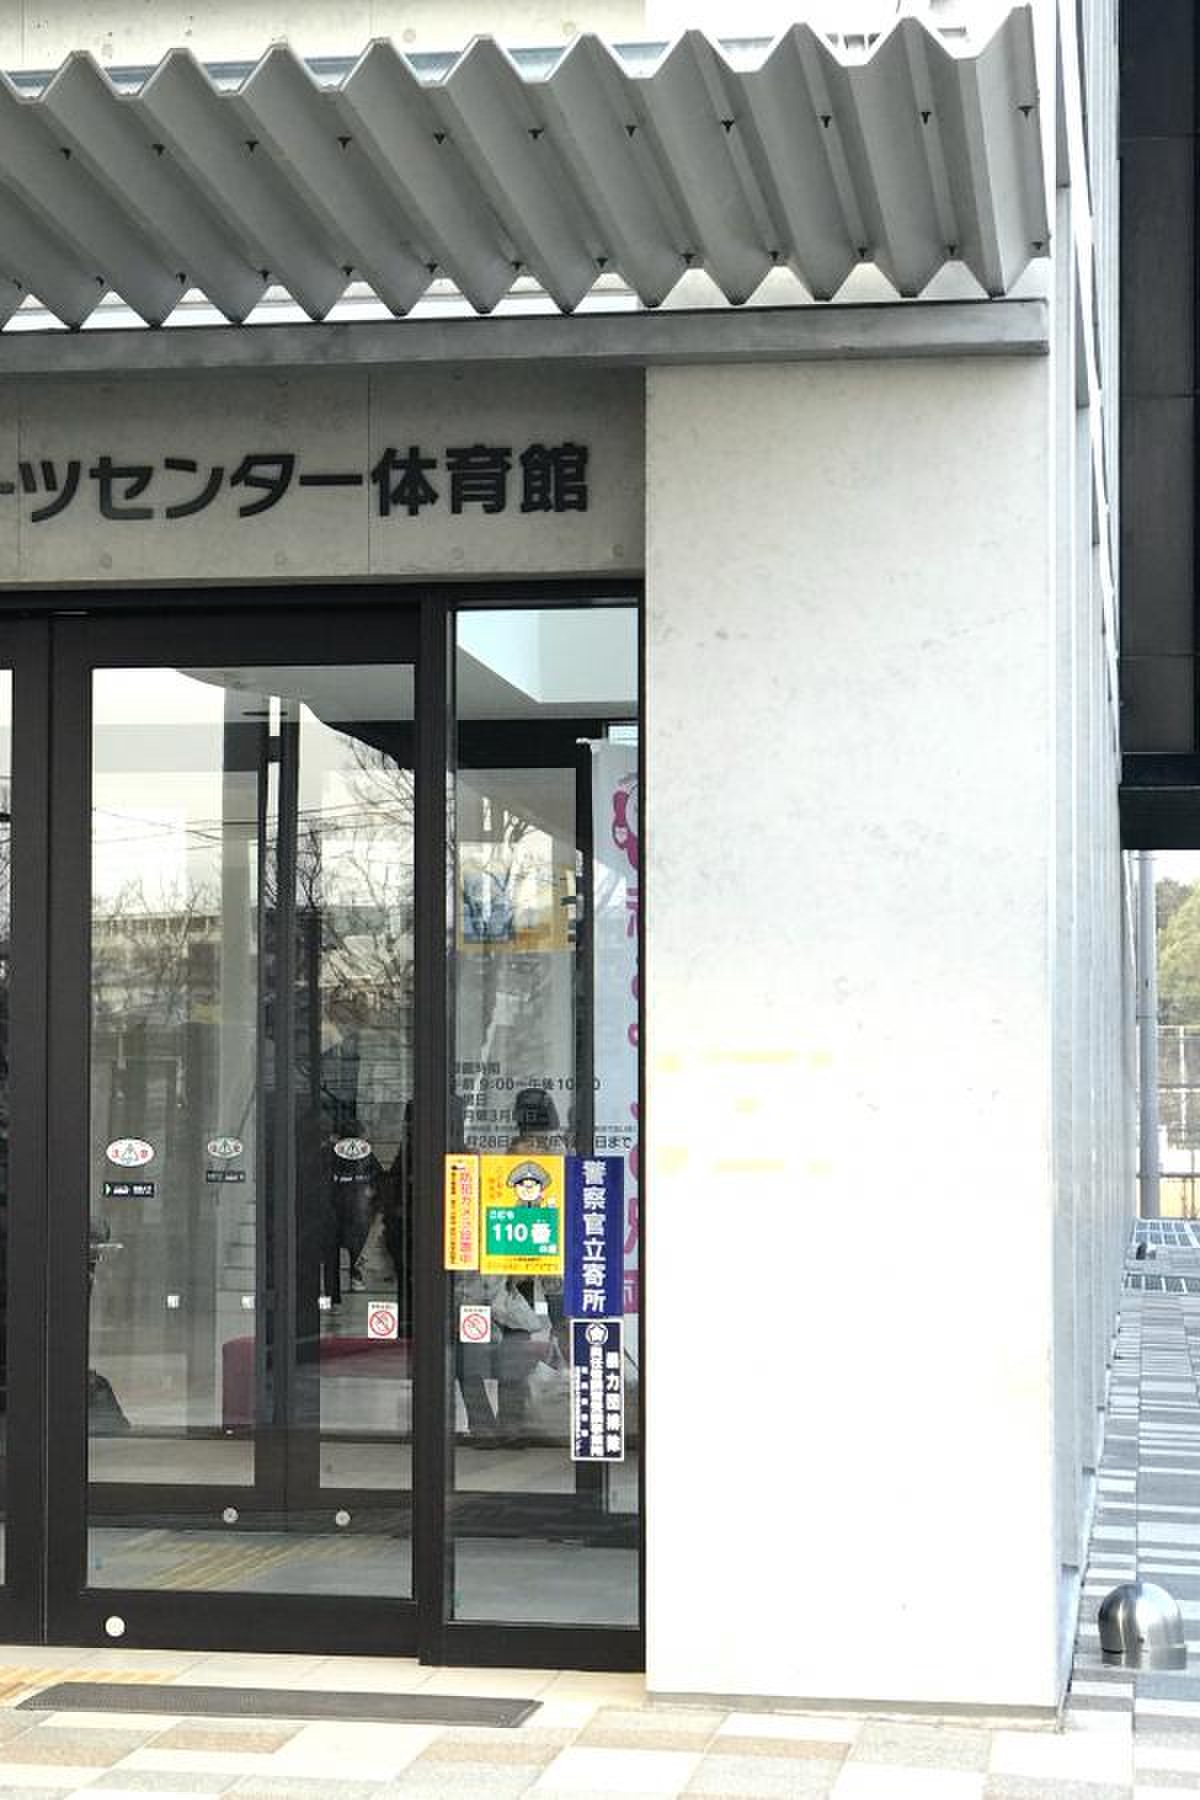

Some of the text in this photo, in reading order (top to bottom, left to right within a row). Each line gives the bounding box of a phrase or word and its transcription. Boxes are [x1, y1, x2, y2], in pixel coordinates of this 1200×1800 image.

[581, 1160, 607, 1313] 警察官立寄所
